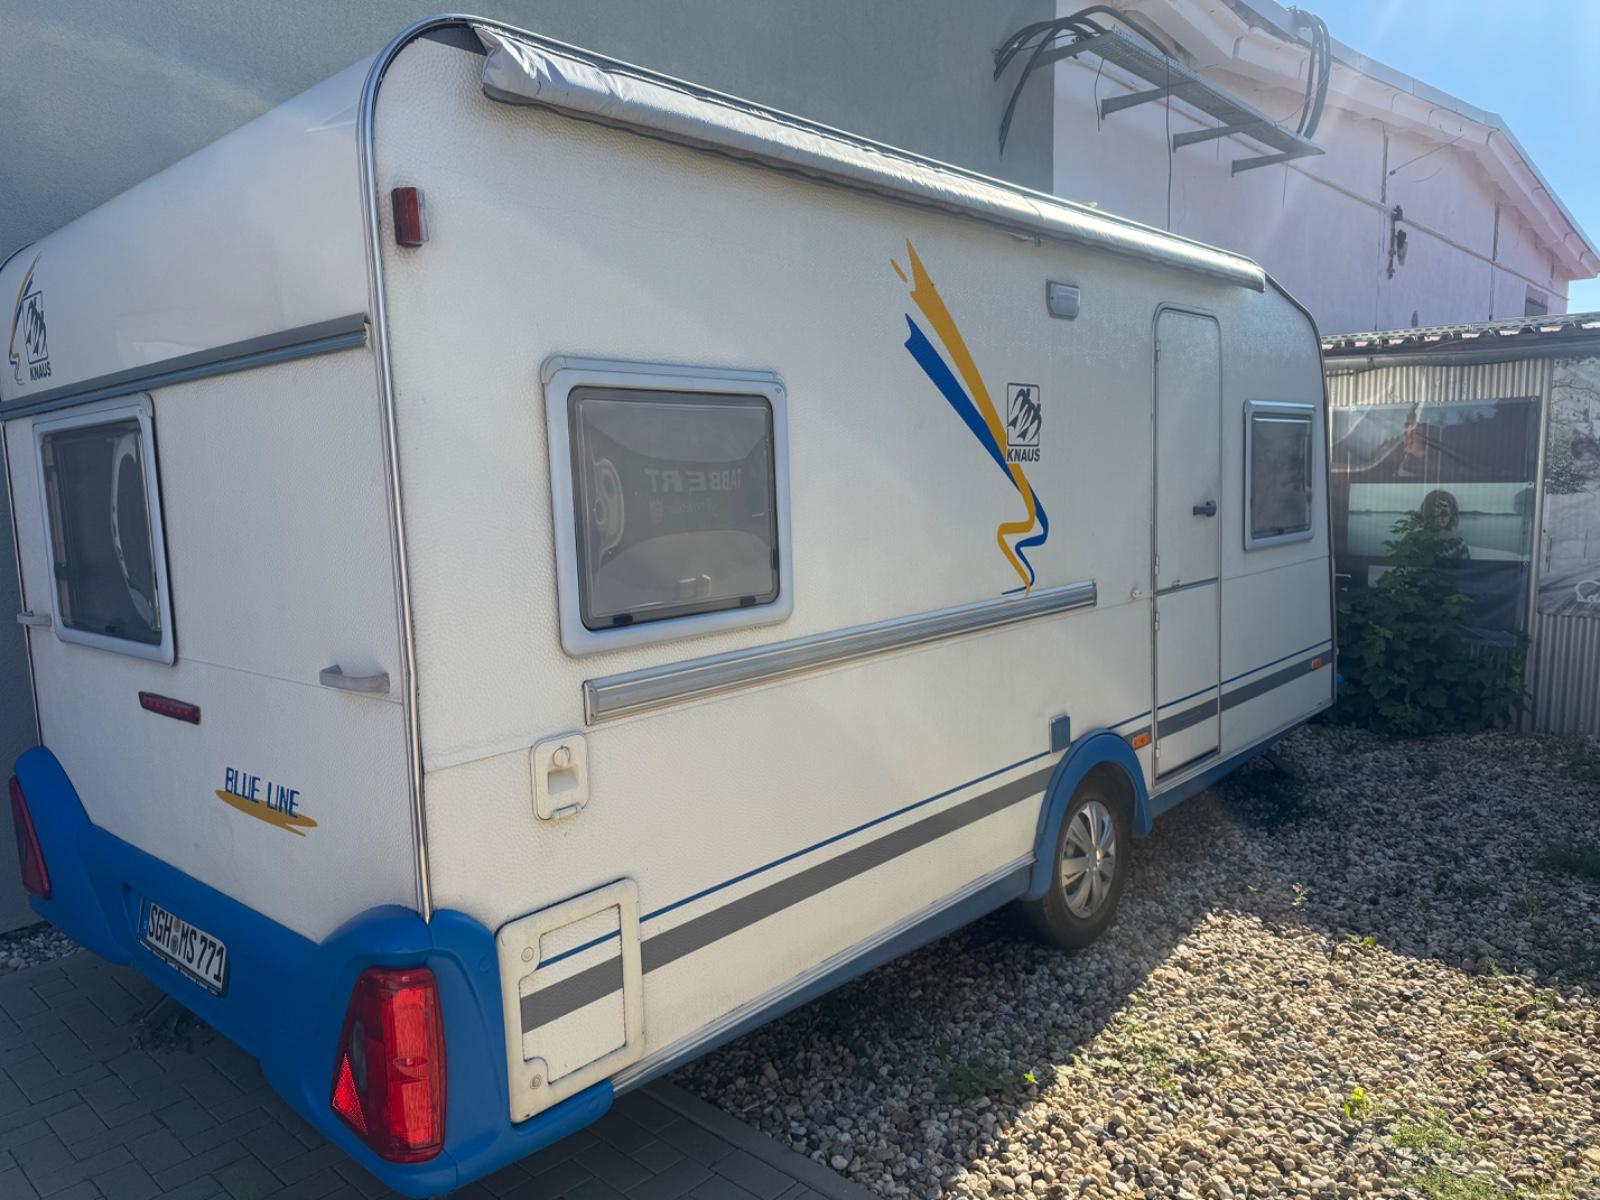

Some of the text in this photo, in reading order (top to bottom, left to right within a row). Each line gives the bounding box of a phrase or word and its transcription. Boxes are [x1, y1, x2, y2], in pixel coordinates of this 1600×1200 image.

[30, 361, 52, 381] KNAUS
[1006, 447, 1041, 463] KNAUS
[225, 766, 300, 819] BLUE LINE
[148, 905, 225, 983] SGH MS 771
